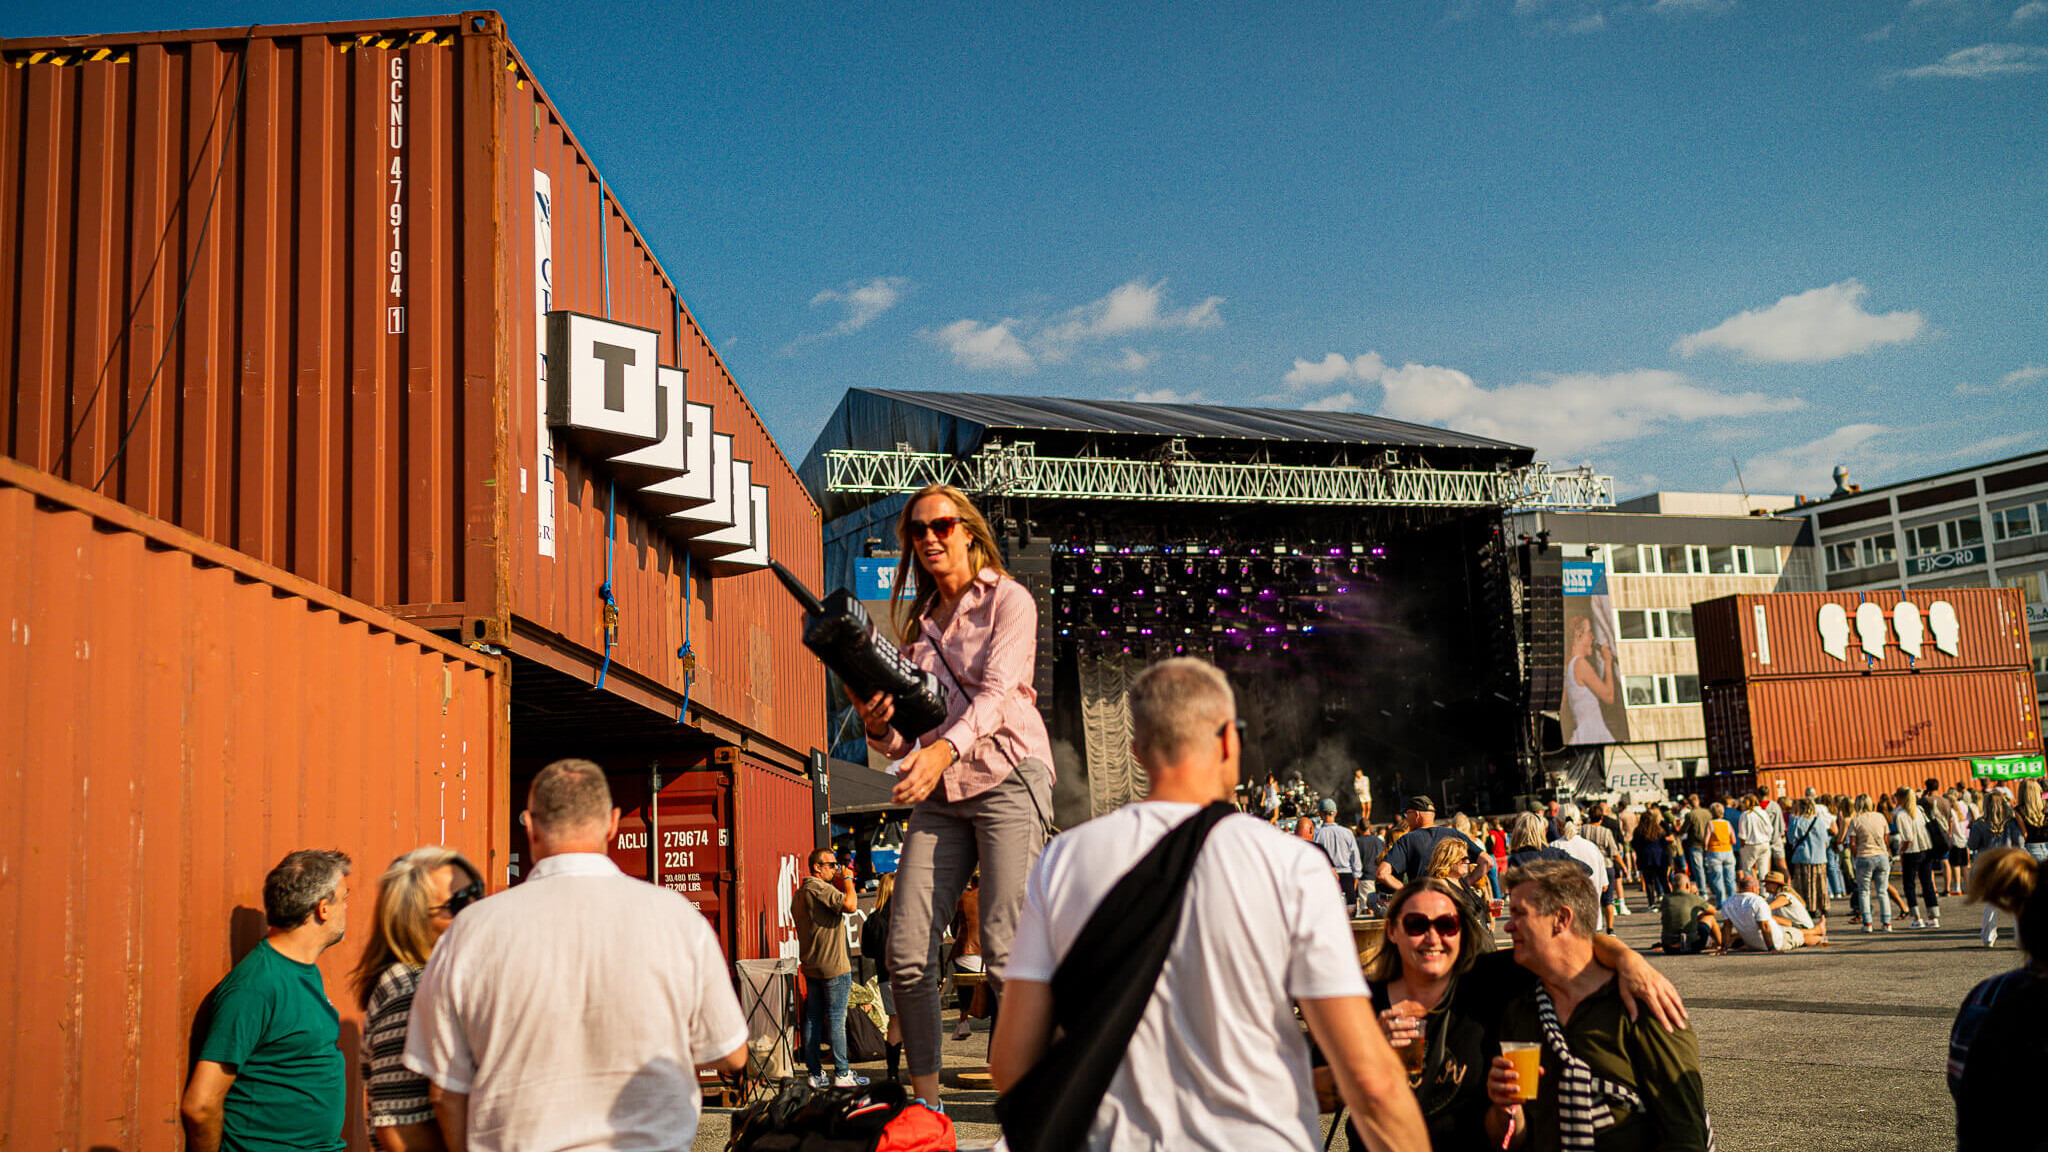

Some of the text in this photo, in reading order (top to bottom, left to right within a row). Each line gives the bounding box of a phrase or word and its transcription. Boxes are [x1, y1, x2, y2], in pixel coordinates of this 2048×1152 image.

[390, 57, 402, 332] GCNU 479194 1
[1611, 772, 1660, 789] FLEET
[617, 829, 729, 850] ACLU 279674 5
[664, 851, 694, 868] 22G1
